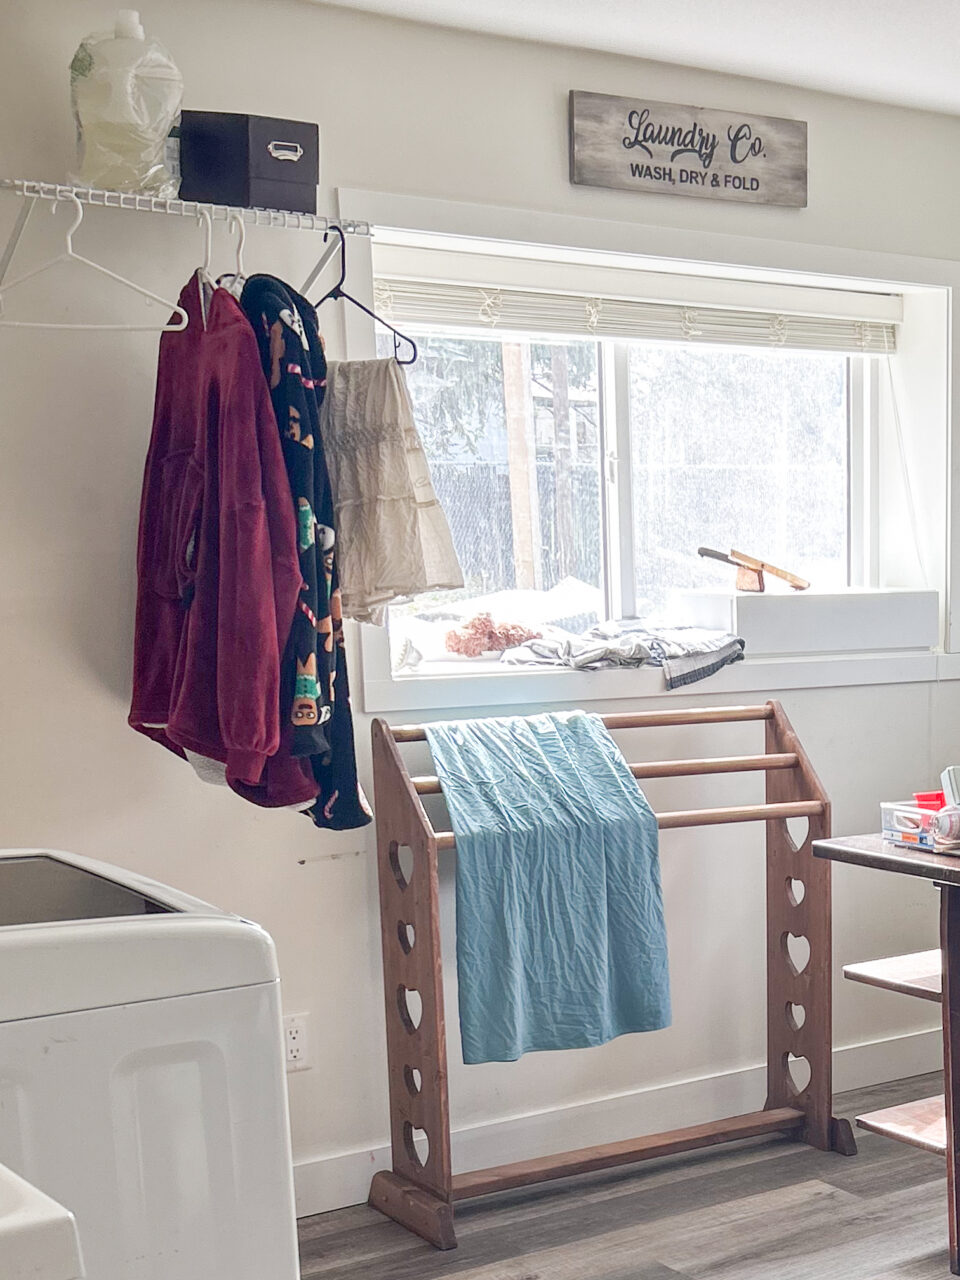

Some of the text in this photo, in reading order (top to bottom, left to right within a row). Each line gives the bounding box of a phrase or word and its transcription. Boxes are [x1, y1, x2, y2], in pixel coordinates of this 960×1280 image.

[622, 109, 767, 169] Laundry Co.
[630, 163, 760, 192] WASH, DRY & FOLD
